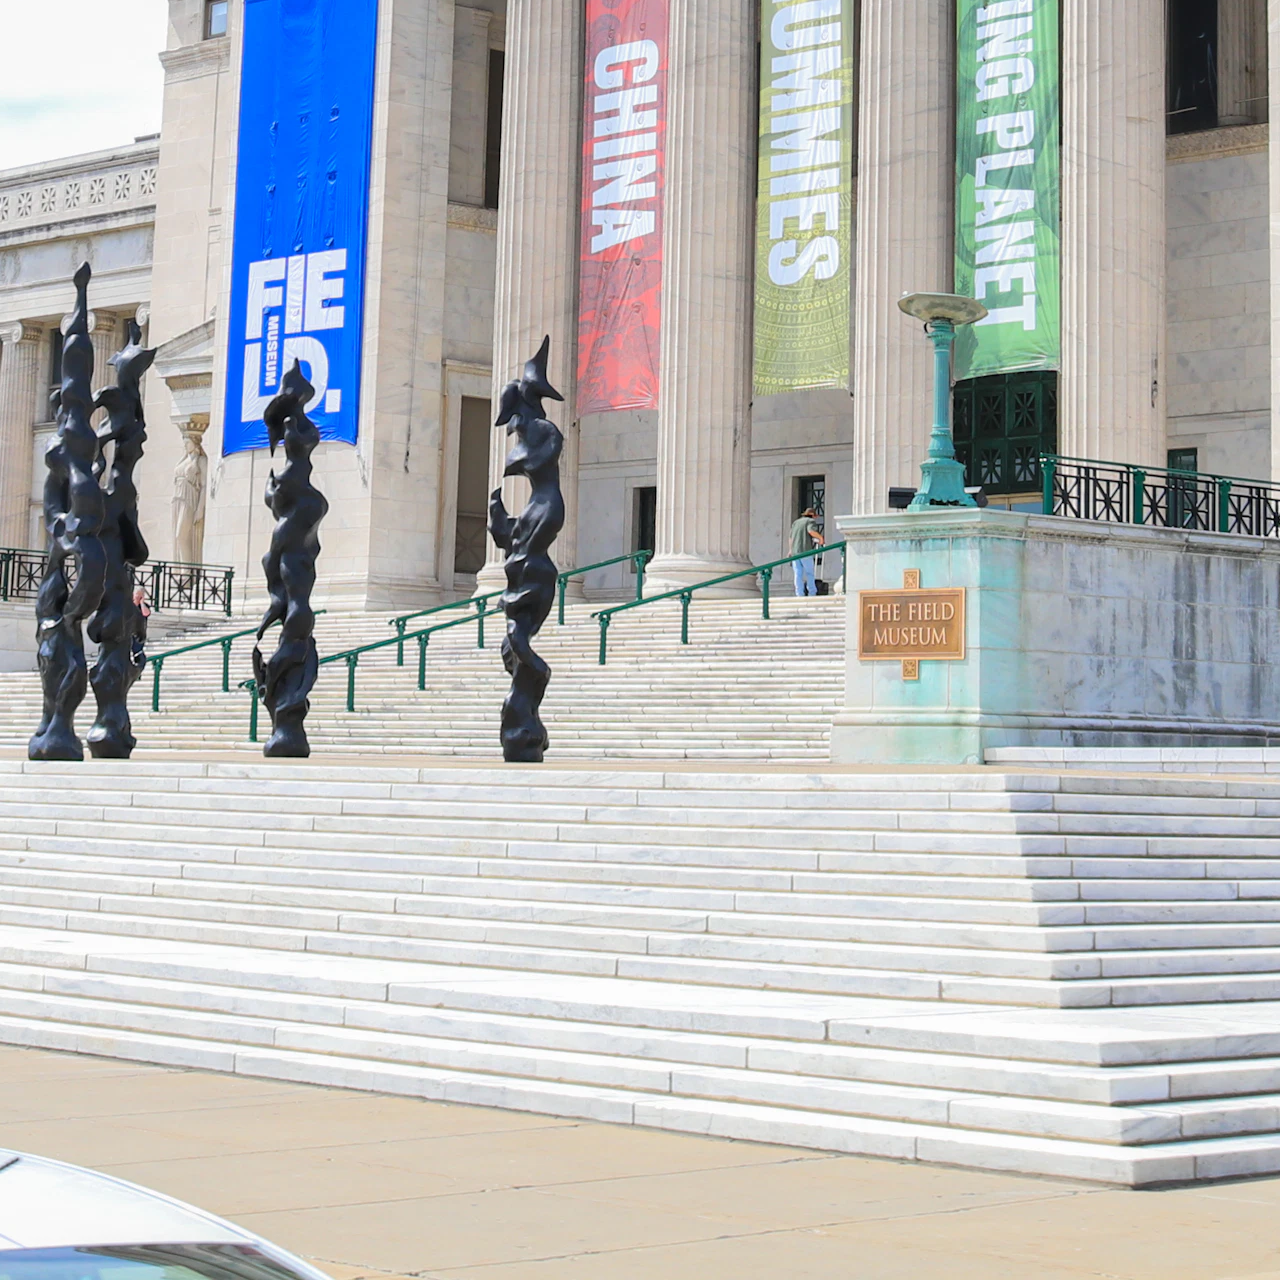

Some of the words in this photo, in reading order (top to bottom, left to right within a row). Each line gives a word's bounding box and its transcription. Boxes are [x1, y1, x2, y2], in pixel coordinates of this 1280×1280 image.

[591, 39, 659, 254] CHINA
[974, 109, 1037, 331] PLANET
[265, 315, 280, 387] MUSEUM
[867, 603, 900, 622] THE
[908, 602, 955, 621] FIELD
[873, 627, 947, 646] MUSEUM
